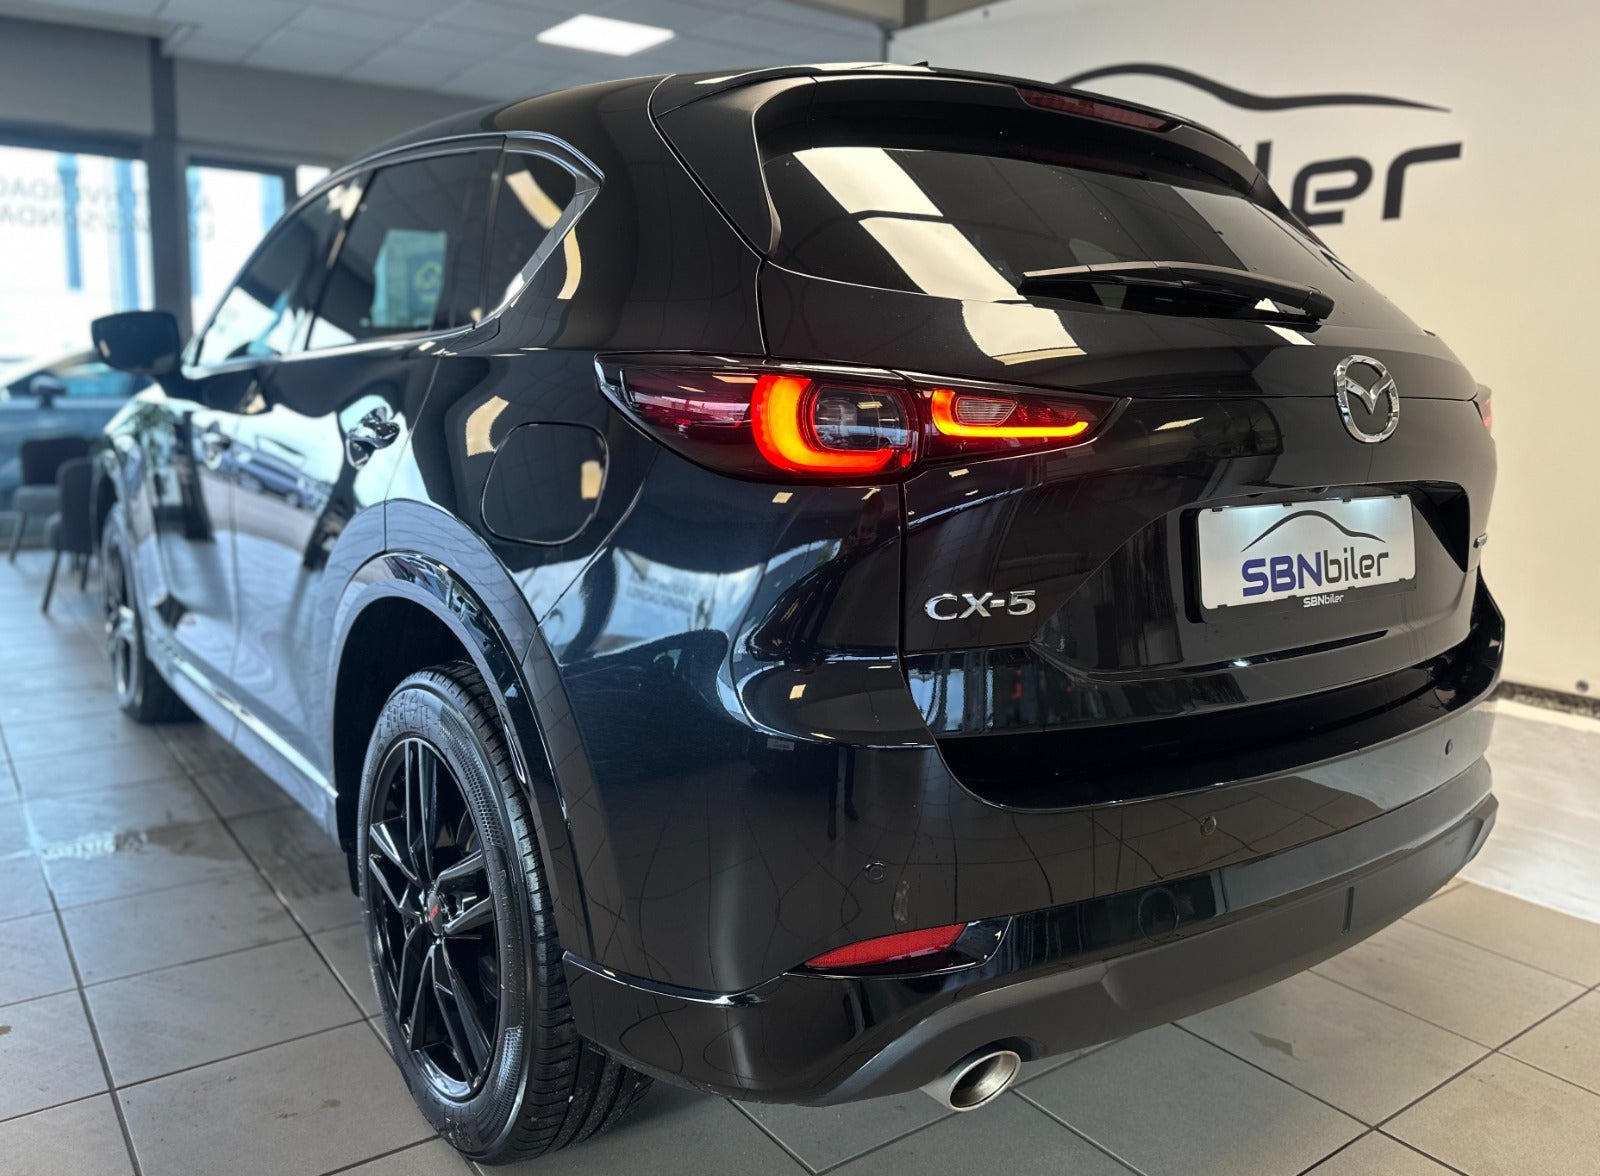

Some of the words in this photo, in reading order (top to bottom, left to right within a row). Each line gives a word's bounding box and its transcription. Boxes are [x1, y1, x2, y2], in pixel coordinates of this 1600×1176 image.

[1241, 546, 1389, 597] SBNbiler
[924, 590, 1036, 621] CX-5
[1303, 593, 1345, 608] SBNbiler
